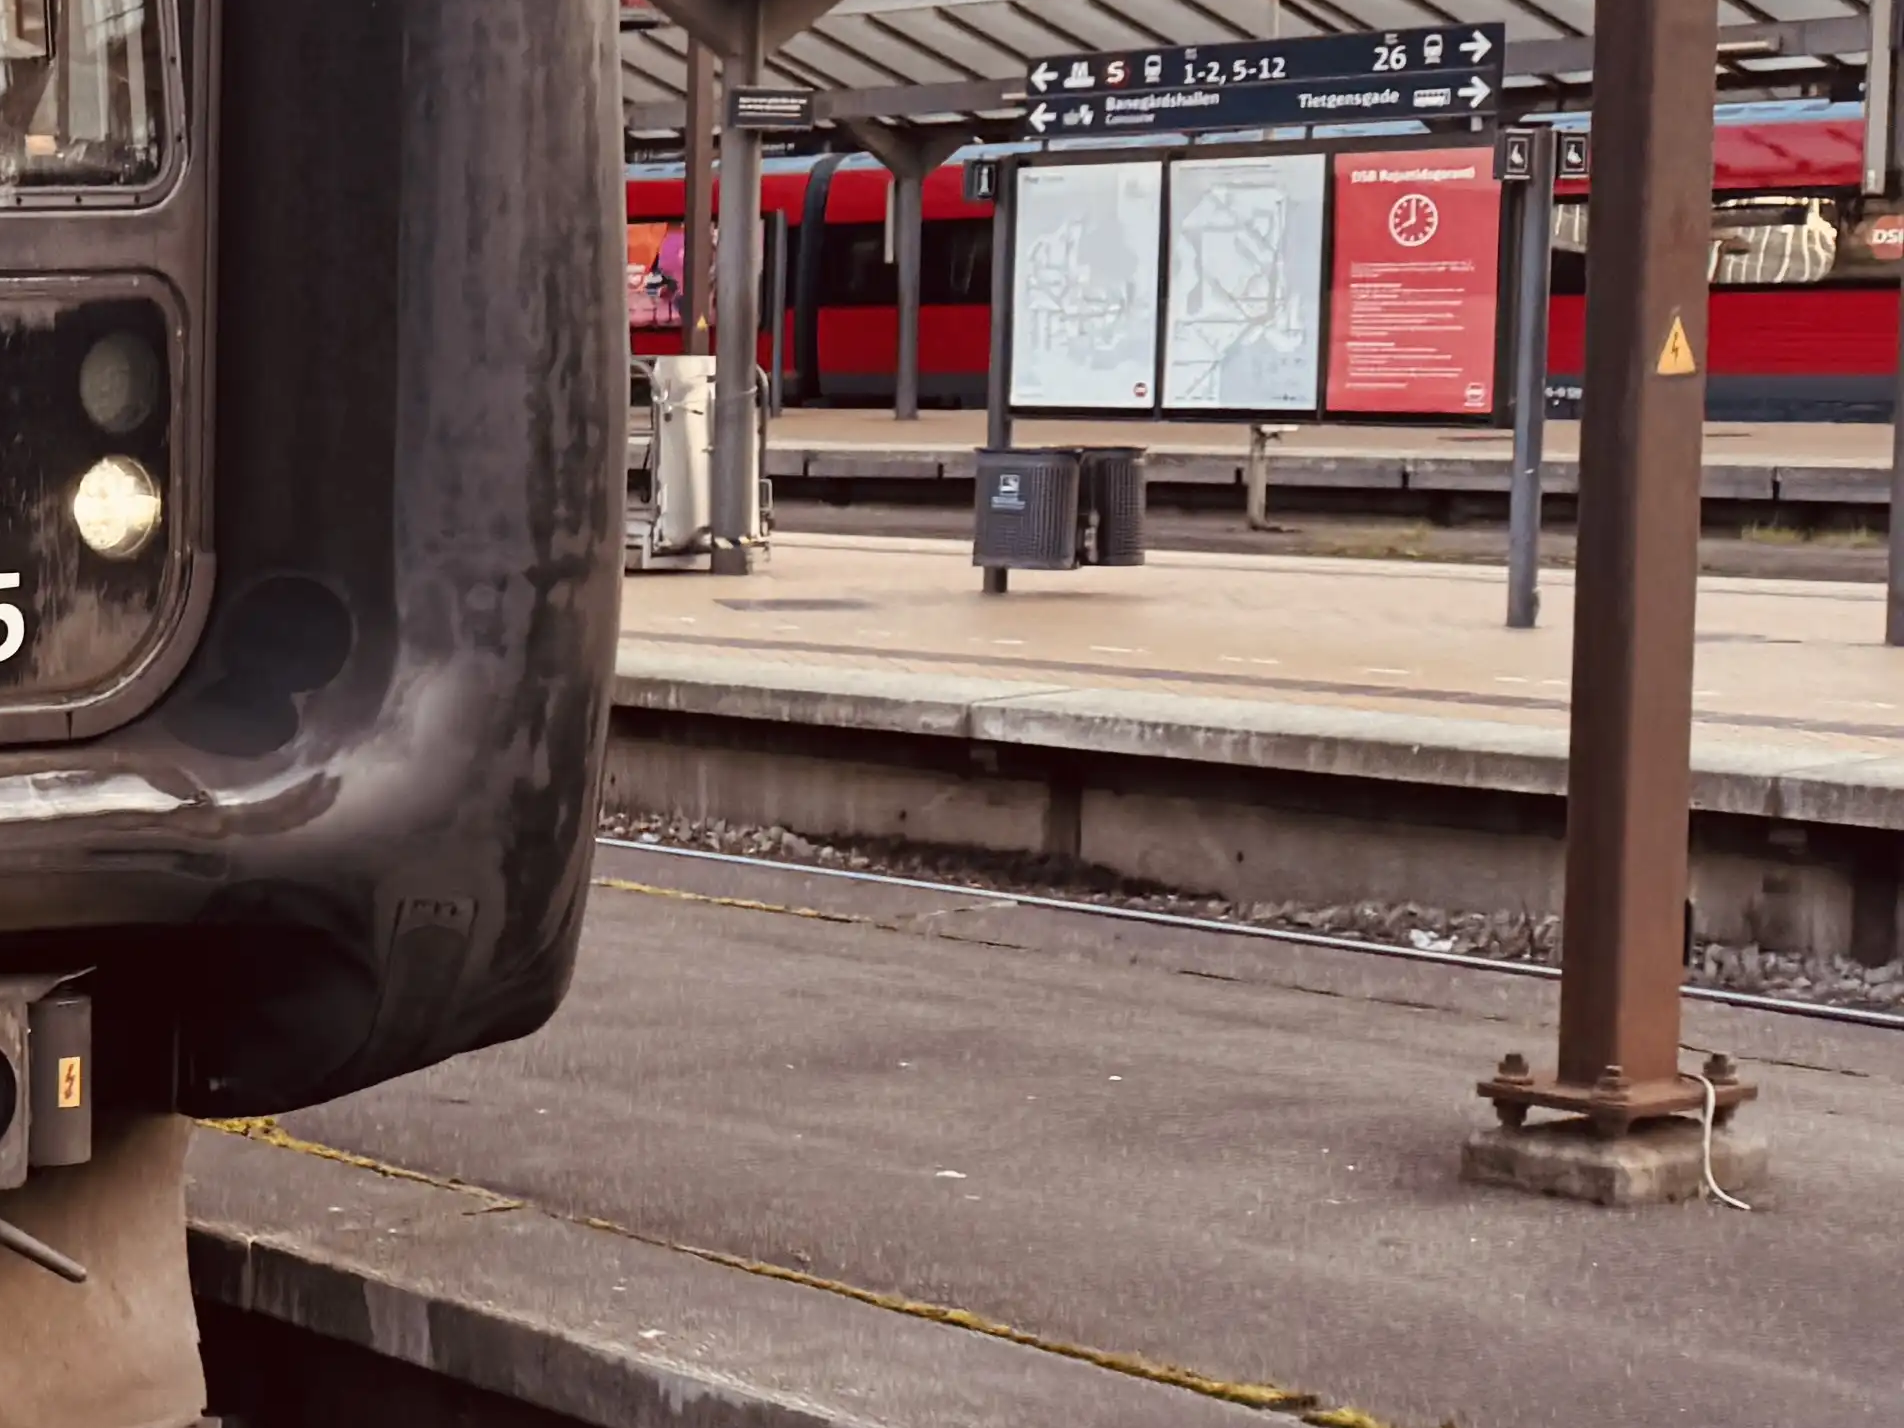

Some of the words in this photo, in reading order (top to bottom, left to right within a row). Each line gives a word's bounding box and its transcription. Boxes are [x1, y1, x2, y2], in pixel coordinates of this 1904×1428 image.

[1106, 61, 1126, 85] S
[1183, 62, 1226, 86] 1-2,
[1232, 57, 1286, 81] 5-12
[1372, 45, 1407, 71] 26
